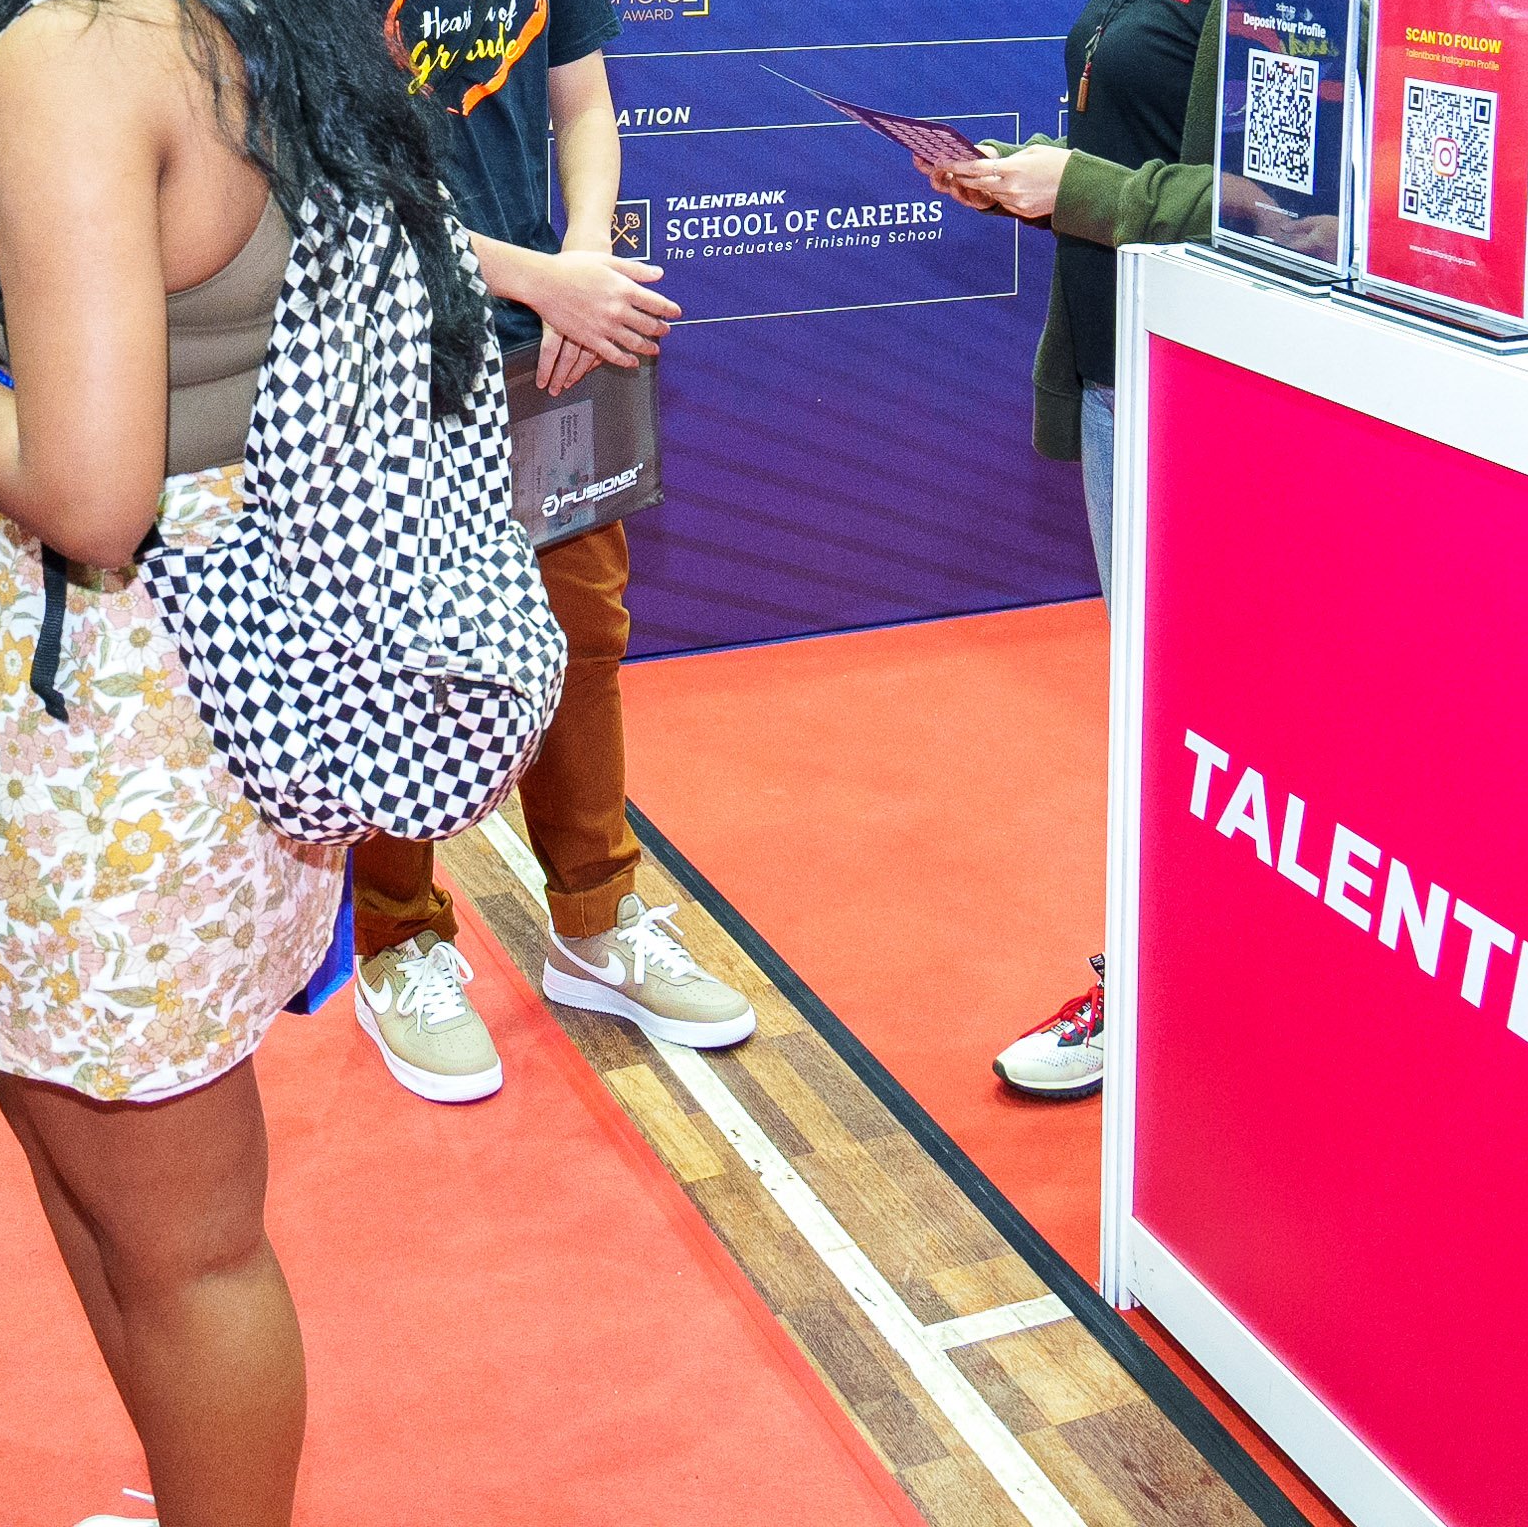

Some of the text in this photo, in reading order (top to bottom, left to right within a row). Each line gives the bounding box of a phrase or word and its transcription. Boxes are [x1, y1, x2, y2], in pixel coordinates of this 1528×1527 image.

[622, 8, 674, 22] AWARD
[1243, 13, 1326, 38] Deposit Your Profile
[1405, 27, 1502, 54] SCAN TO FOLLOW
[1405, 48, 1500, 71] Talentbank Instagram Profile
[616, 106, 691, 127] ATION
[666, 190, 787, 211] TALENTBANK
[666, 200, 944, 241] SCHOOL OF CAREERS
[665, 244, 698, 259] The
[805, 232, 882, 254] Finishing
[887, 226, 943, 244] School
[560, 467, 639, 508] FUSIONEX
